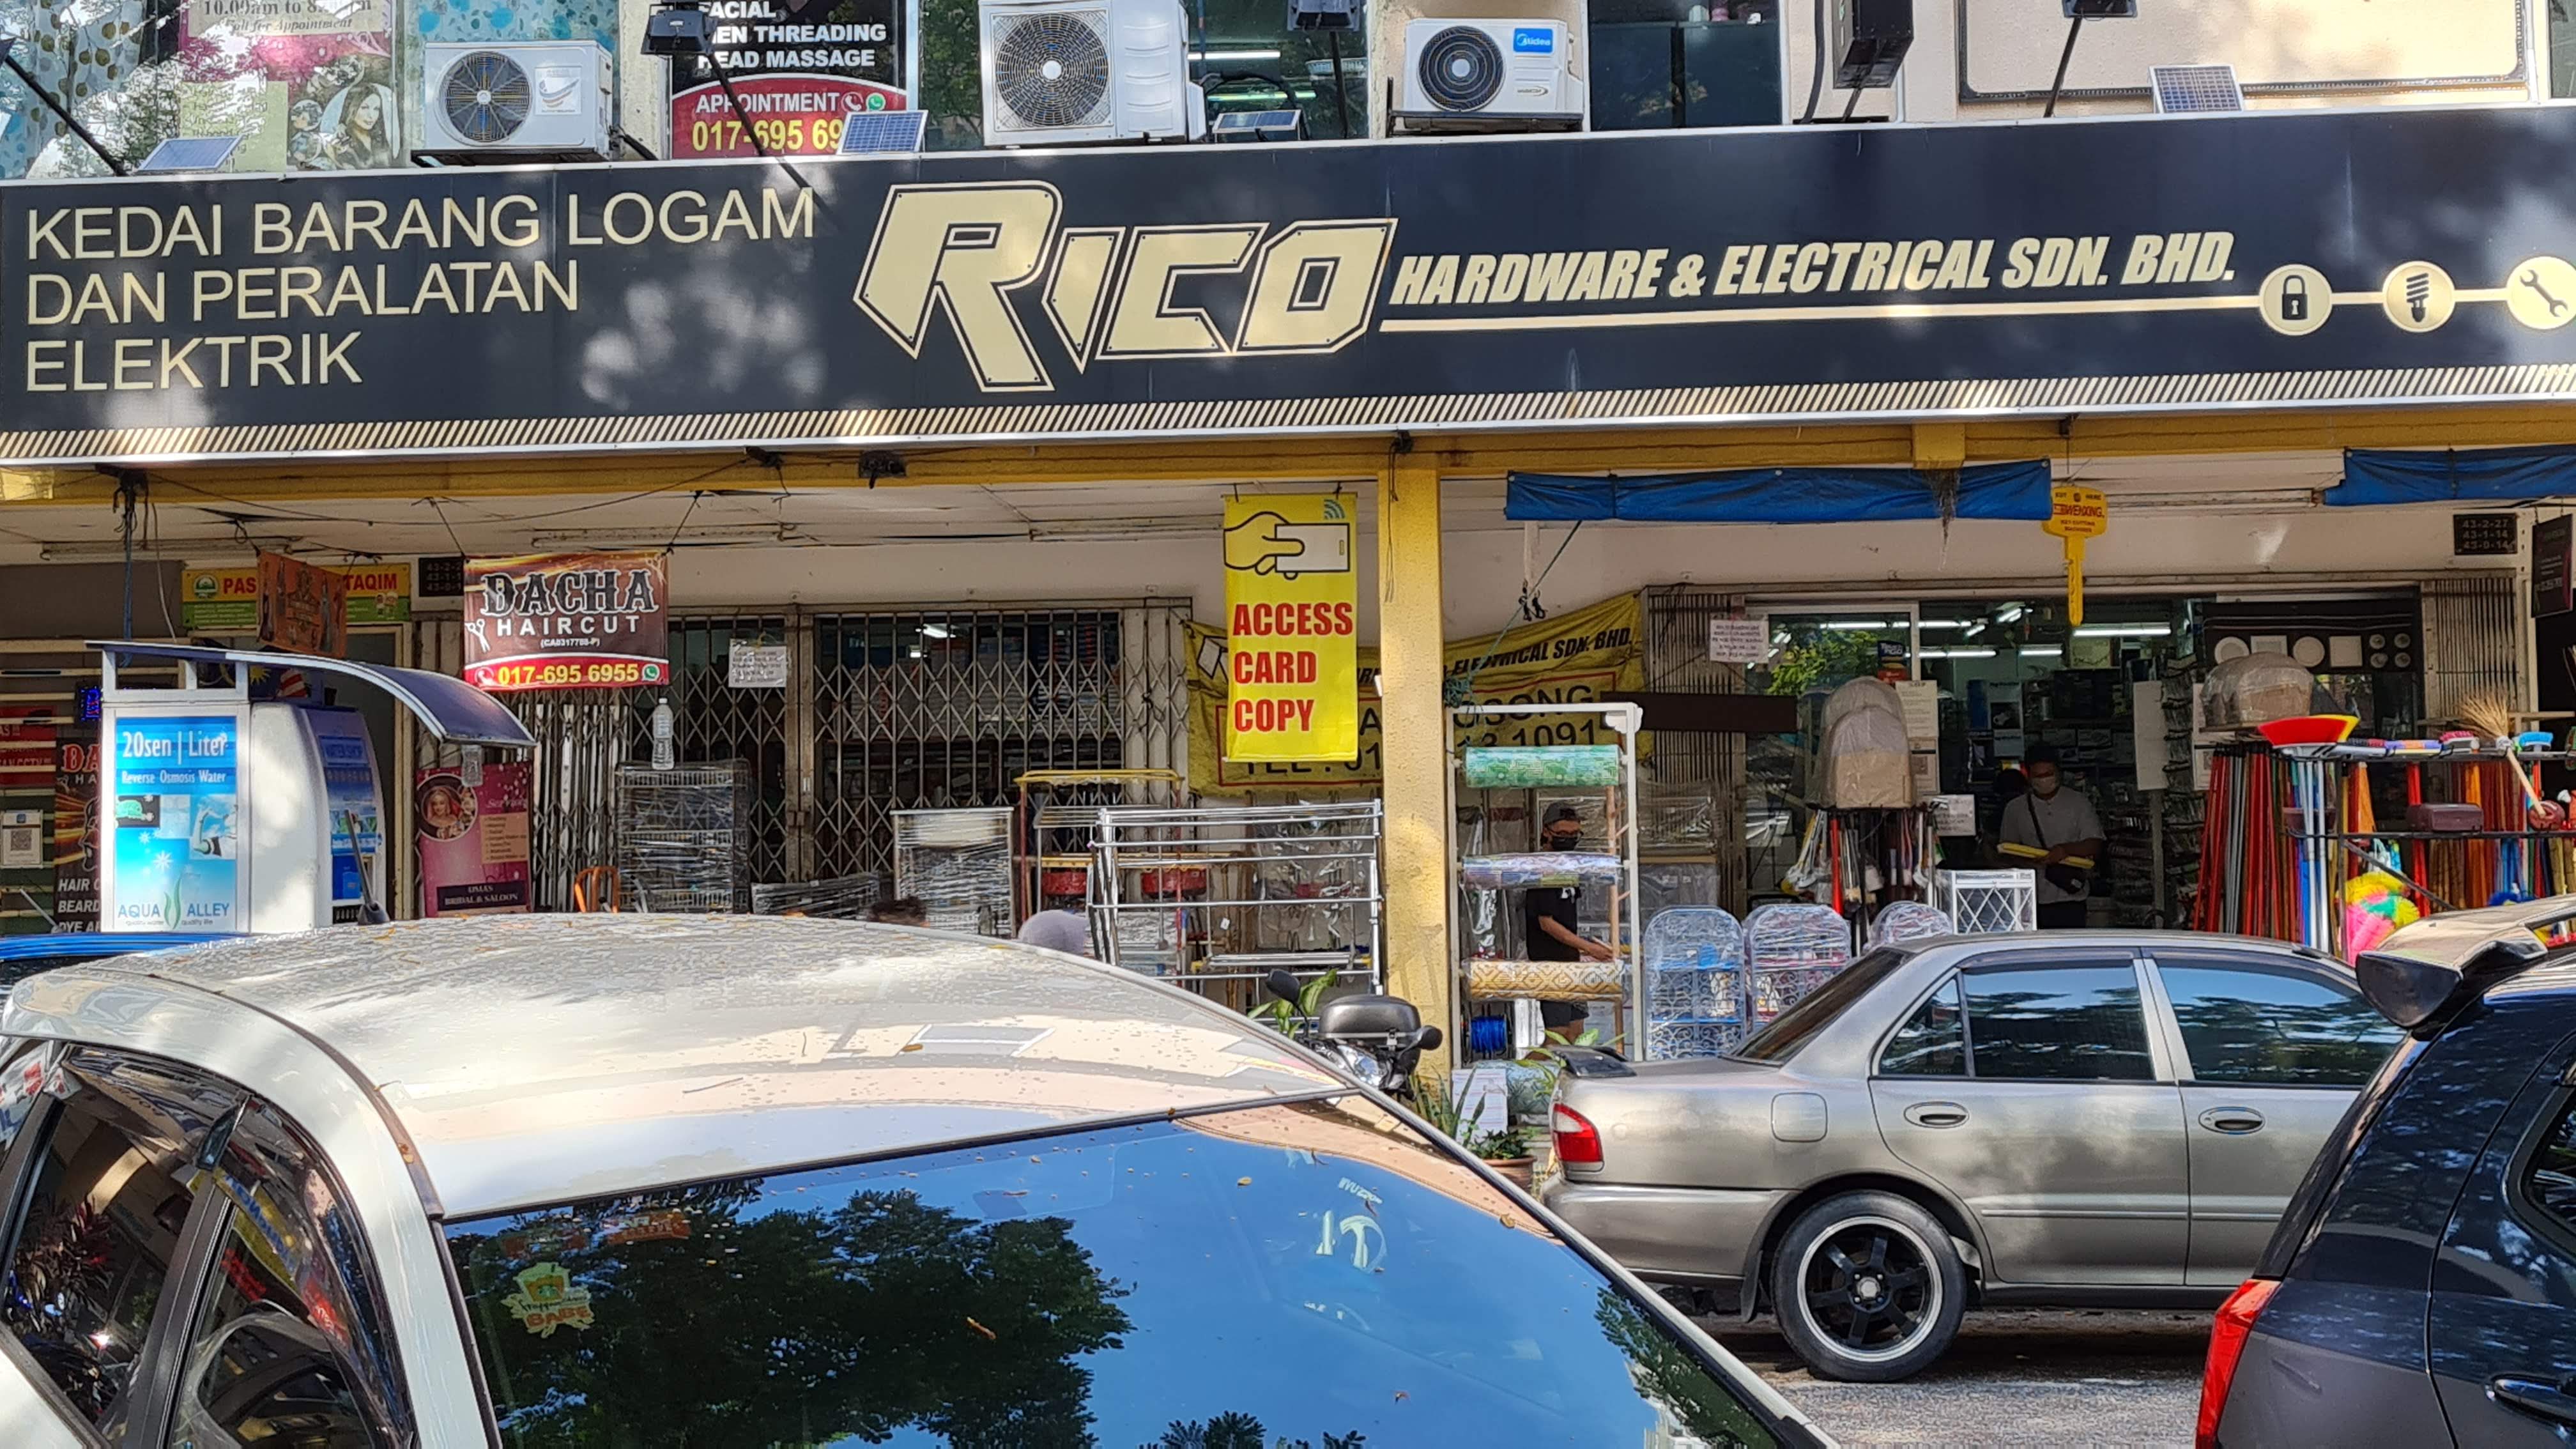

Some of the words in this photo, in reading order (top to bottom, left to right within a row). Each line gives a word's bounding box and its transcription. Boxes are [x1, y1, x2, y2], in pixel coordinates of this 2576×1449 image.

[287, 1, 301, 14] to
[756, 24, 887, 43] THREADING
[766, 49, 876, 68] MASSAGE
[692, 119, 803, 151] 017-695
[811, 118, 844, 151] 69
[27, 203, 222, 260] KEDAI
[254, 194, 540, 255] BARANG
[568, 186, 814, 246] LOGAM
[1388, 248, 1669, 305] HARDWARE
[1668, 252, 1706, 298] &
[1713, 238, 1995, 296] ELECTRICAL
[2002, 236, 2110, 289] SDN.
[2120, 231, 2235, 286] BHD.
[27, 271, 165, 326] DAN
[193, 259, 579, 322] PERALATAN
[853, 180, 1399, 392] RICO
[26, 330, 364, 392] ELEKTRIK
[223, 576, 257, 594] PAS
[343, 572, 398, 592] TAQIM
[479, 568, 660, 618] DACHA
[496, 615, 640, 637] HAIRCUT
[1232, 602, 1354, 637] ACCESS
[498, 664, 582, 686] 017-695
[588, 663, 640, 683] 6955
[1233, 650, 1317, 686] CARD
[1234, 698, 1315, 733] COPY
[122, 731, 172, 758] 20sen
[122, 770, 155, 784] Reverse
[160, 770, 195, 784] Osmosis
[198, 770, 226, 783] Water
[57, 878, 91, 892] HAIR
[118, 903, 161, 918] AQUA
[187, 902, 230, 917] ALLEY
